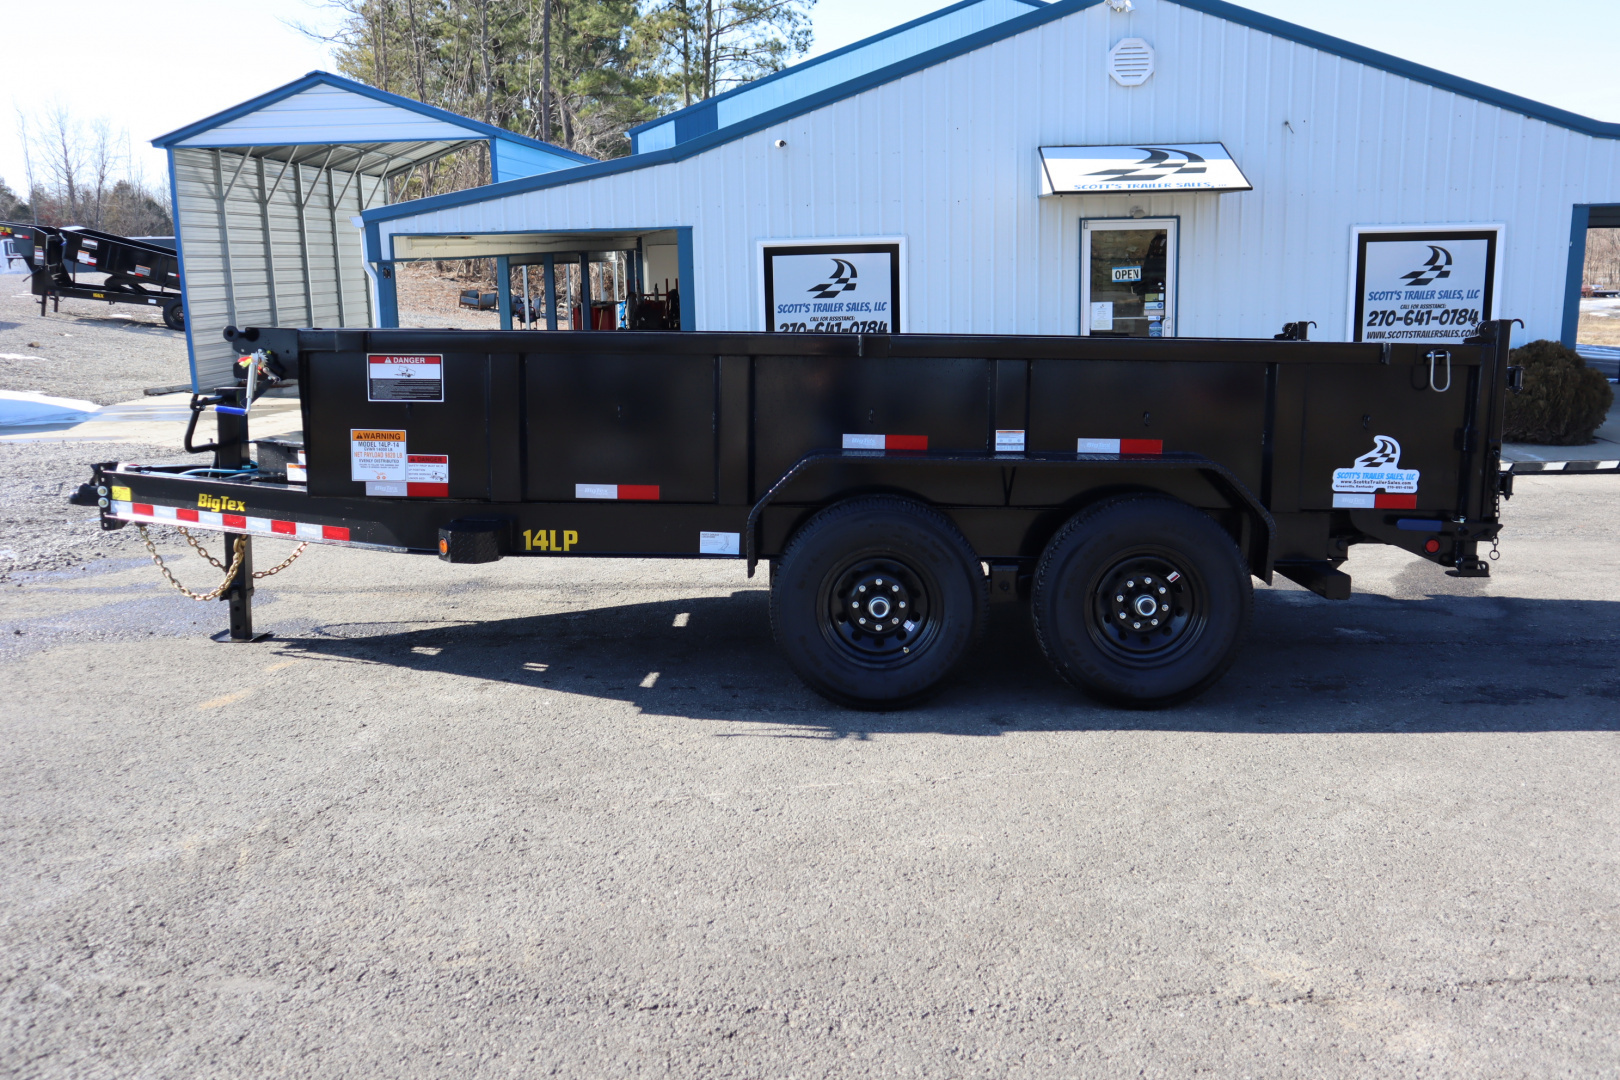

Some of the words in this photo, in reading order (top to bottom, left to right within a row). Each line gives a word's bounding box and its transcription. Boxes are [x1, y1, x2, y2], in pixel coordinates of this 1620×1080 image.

[1114, 269, 1140, 280] OPEN
[1368, 290, 1402, 302] SCOTT'S
[1404, 290, 1437, 300] TRAILER
[1438, 290, 1464, 300] SALES,
[1466, 289, 1480, 299] LLC
[777, 303, 810, 314] SCOTT'S
[812, 303, 844, 312] TRAILER
[846, 302, 872, 313] SALES,
[874, 302, 888, 311] LLC
[1366, 308, 1479, 327] 270-641-0784
[198, 493, 246, 513] BigTex
[522, 529, 578, 551] 14LP
